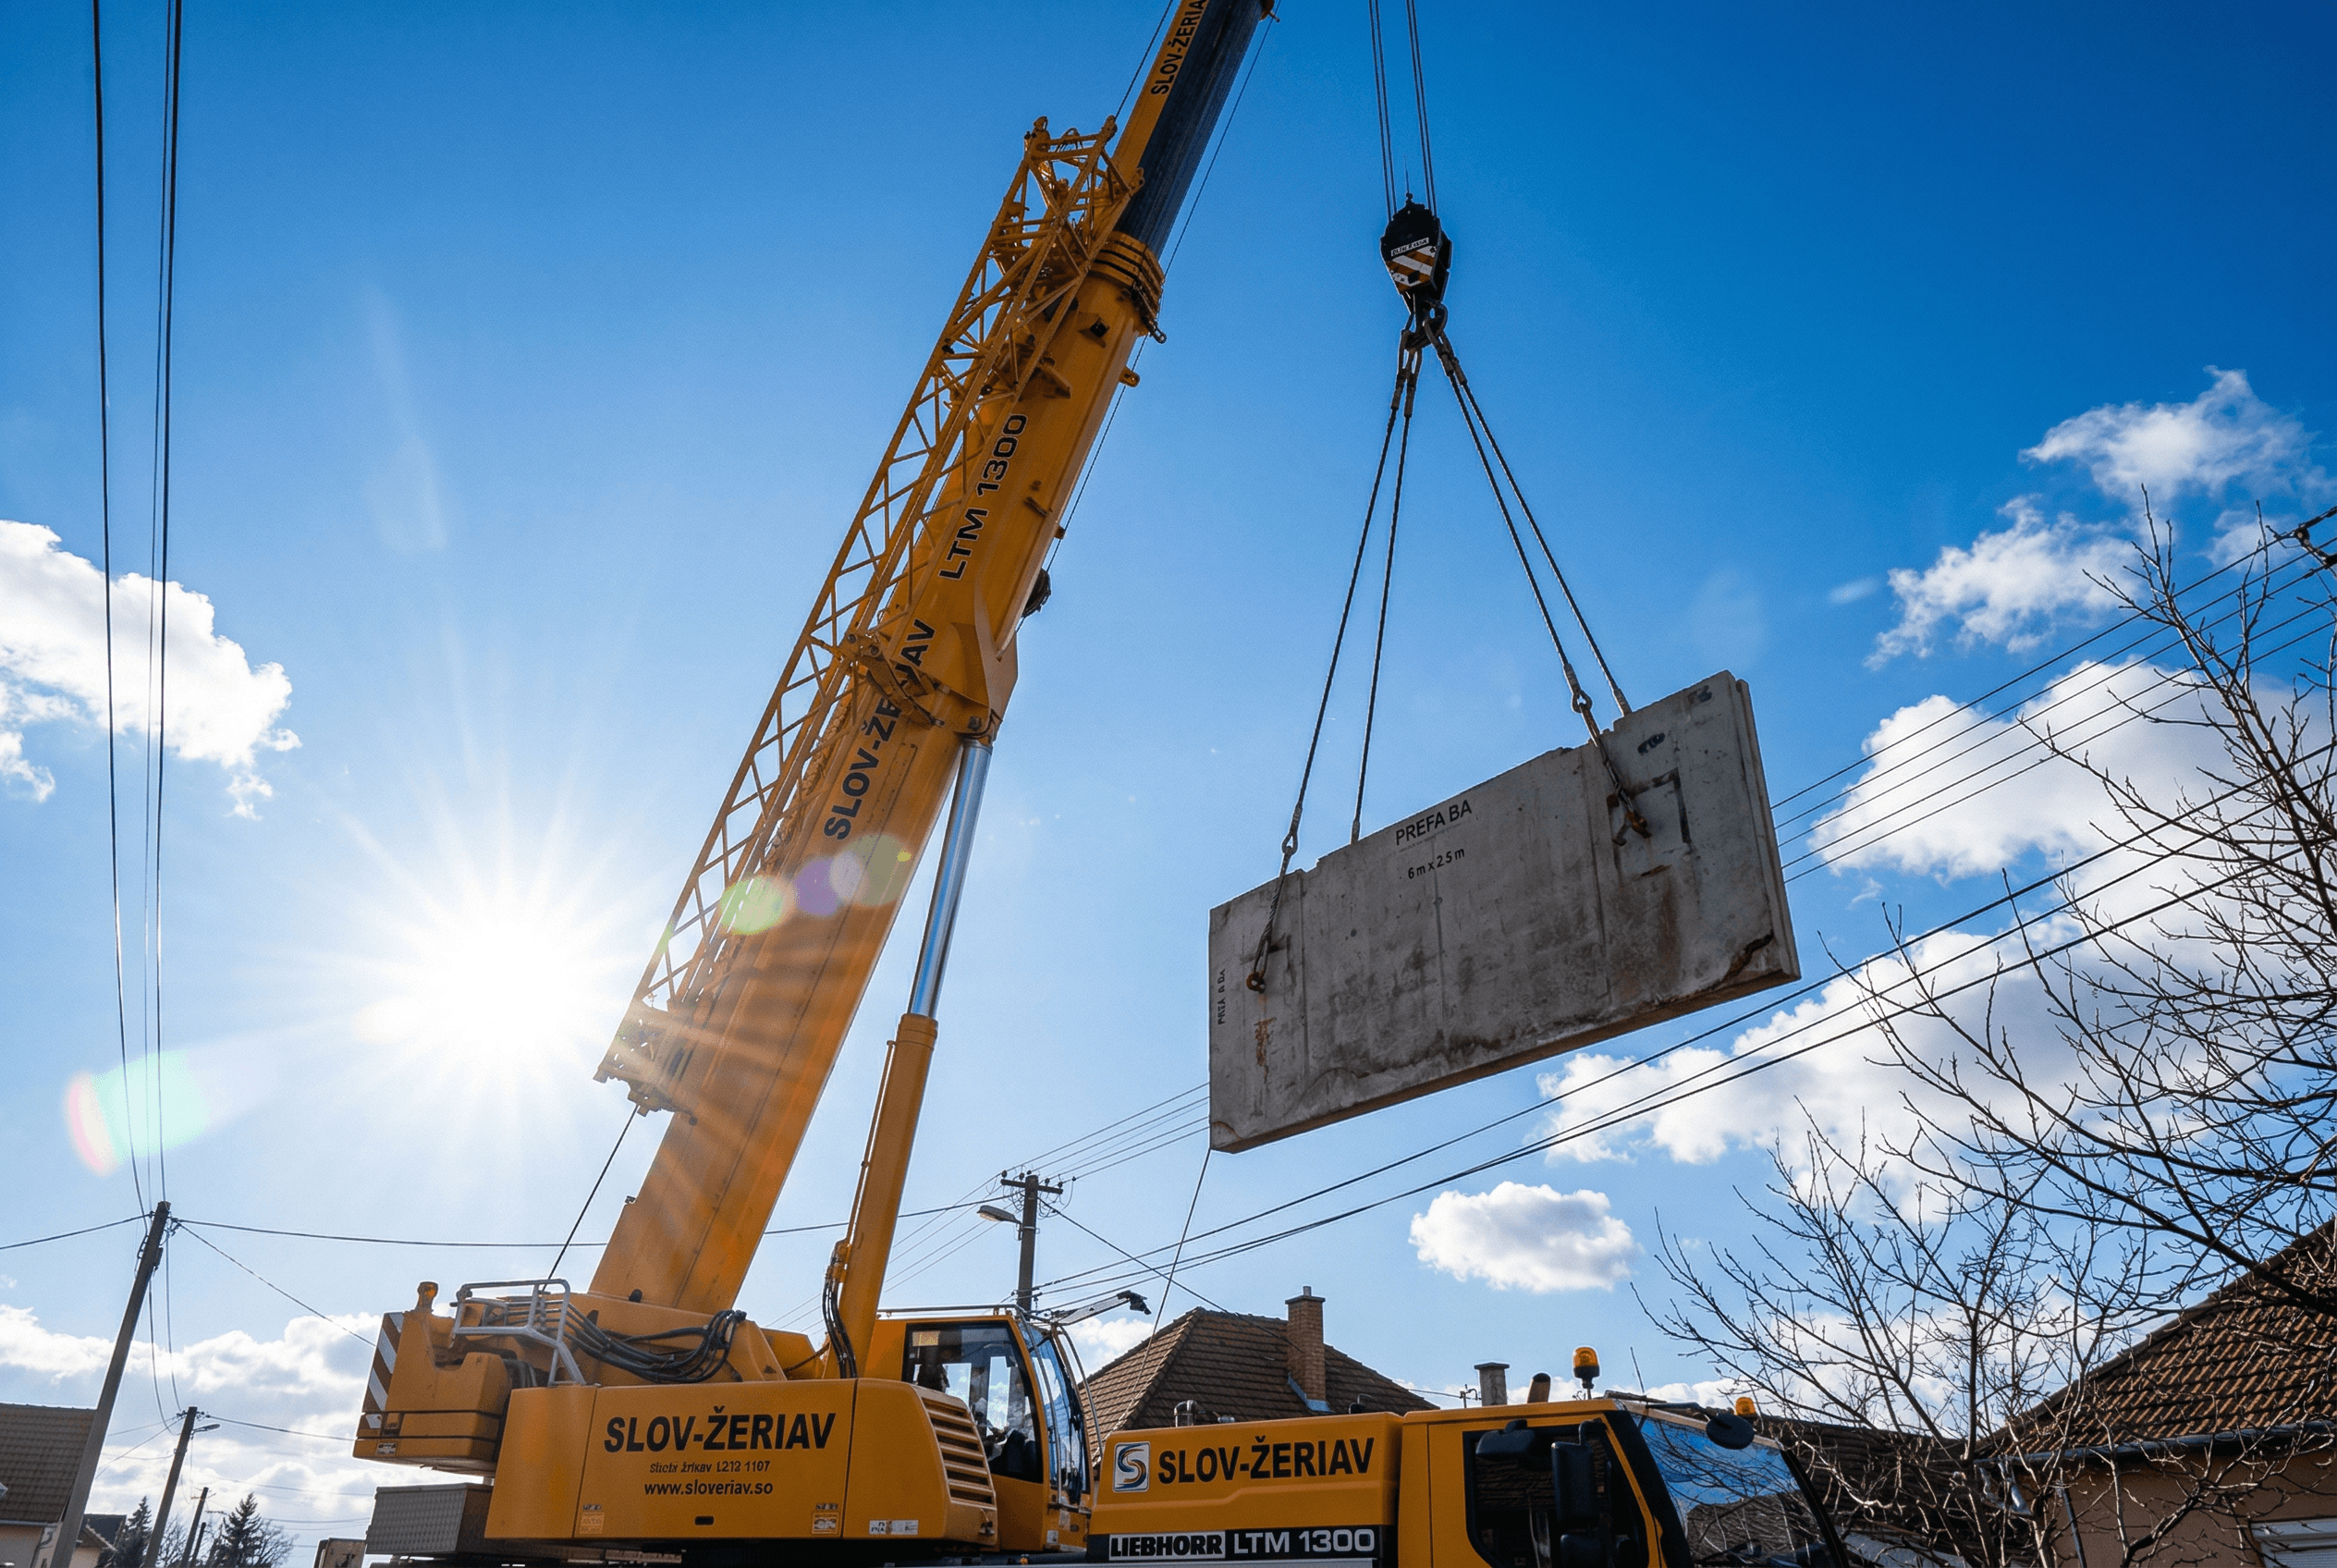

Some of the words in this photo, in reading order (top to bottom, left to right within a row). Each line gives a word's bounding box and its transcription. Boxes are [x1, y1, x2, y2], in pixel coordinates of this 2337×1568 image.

[938, 508, 988, 580] LTM
[976, 414, 1028, 497] 1300
[1396, 812, 1446, 846] PREFA
[1449, 800, 1473, 822] BA
[604, 1405, 837, 1452] SLOV-ŽERIAV
[1157, 1435, 1375, 1485] SLOV-ŽERIAV
[644, 1479, 774, 1495] www.sloveriav.so
[1110, 1534, 1223, 1557] LIEBHORR
[1233, 1532, 1291, 1554] LTM
[1298, 1528, 1376, 1553] 1300
